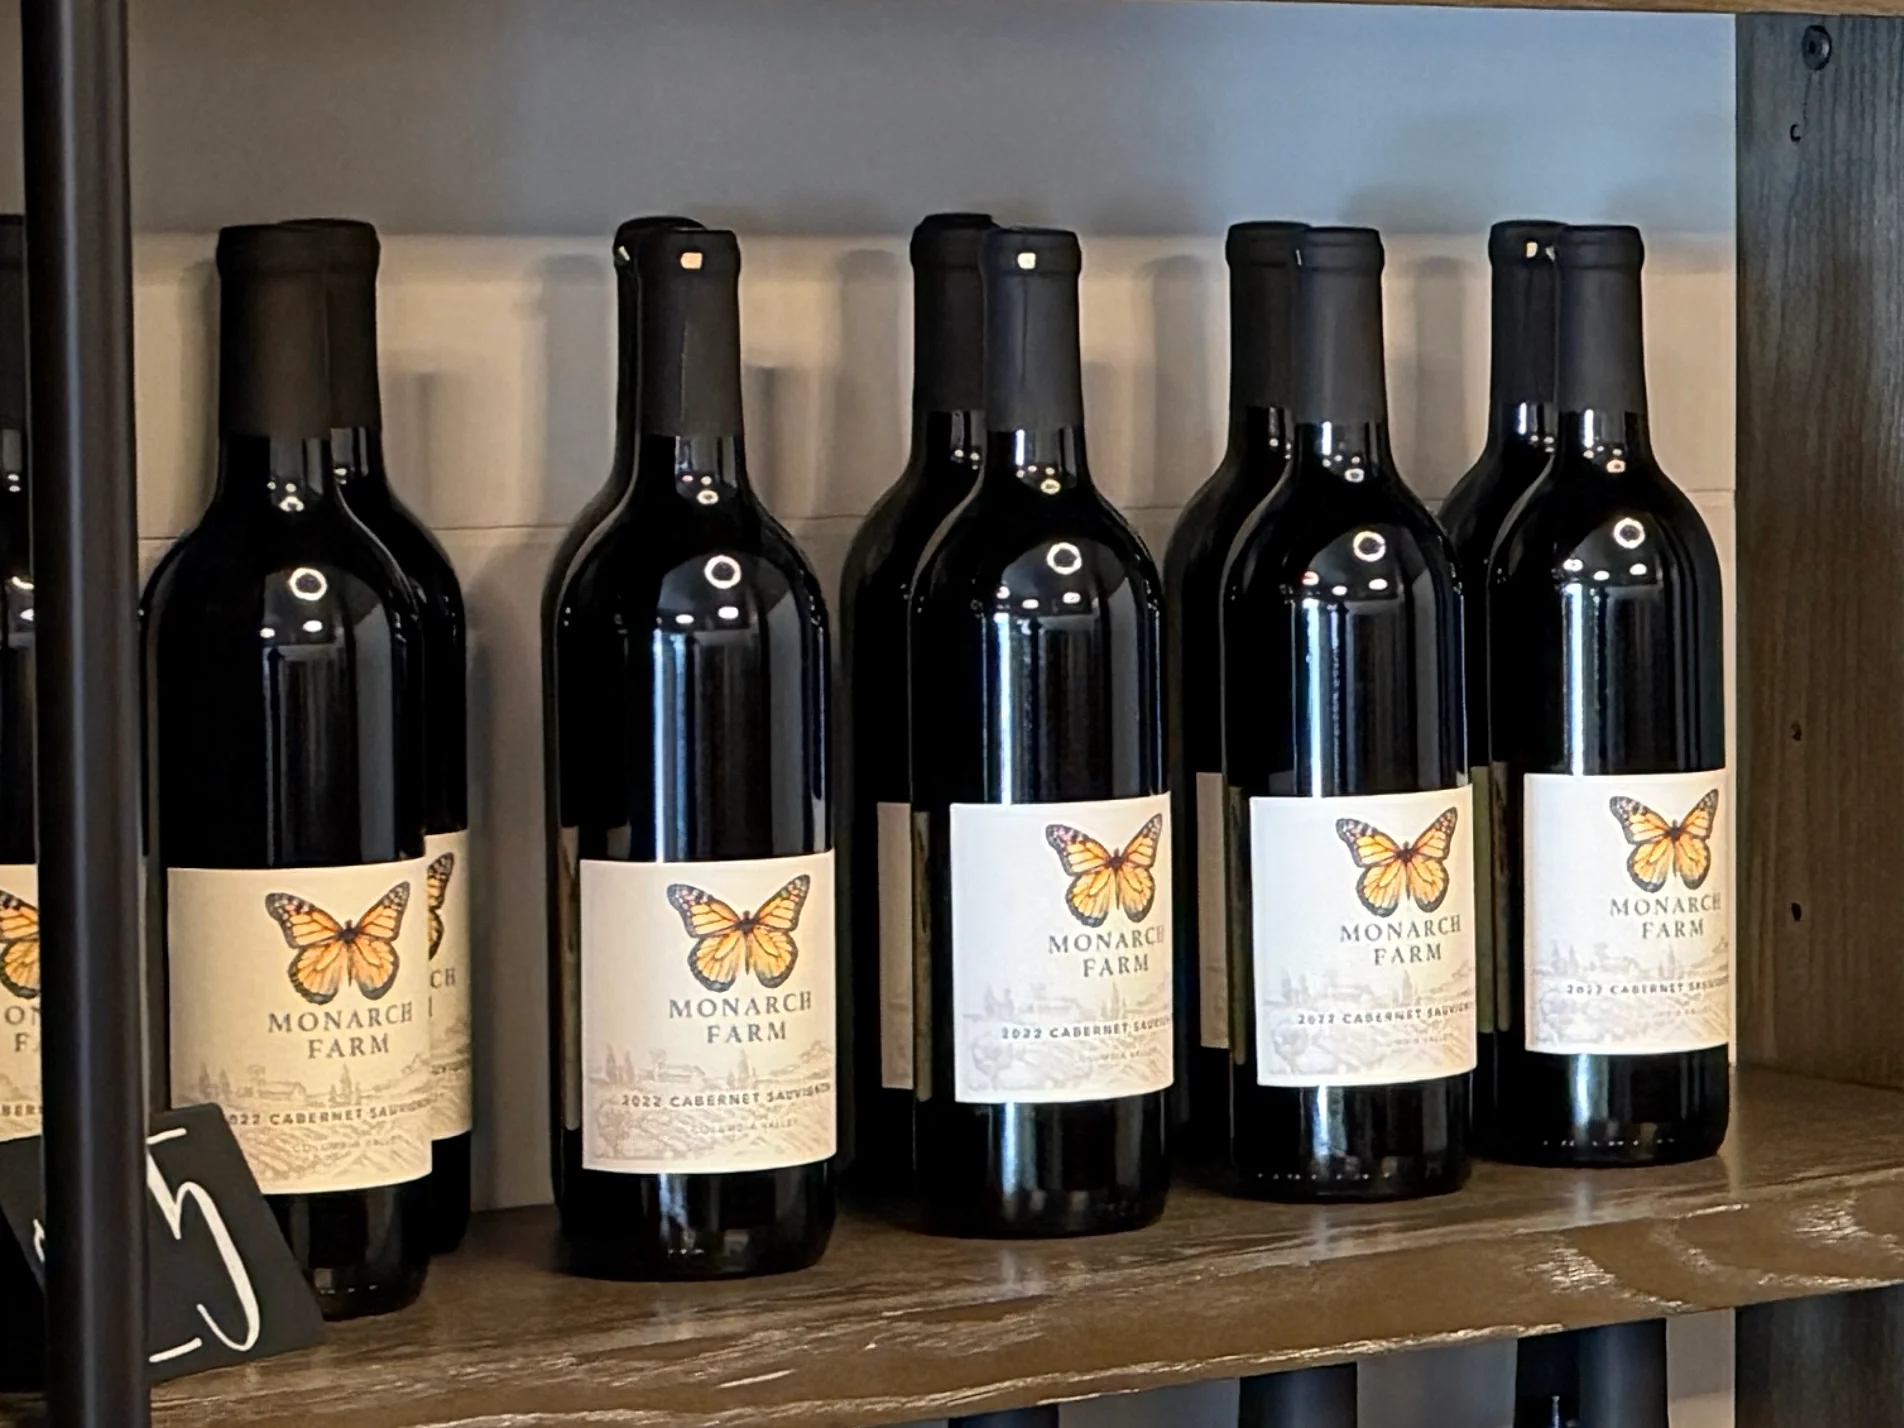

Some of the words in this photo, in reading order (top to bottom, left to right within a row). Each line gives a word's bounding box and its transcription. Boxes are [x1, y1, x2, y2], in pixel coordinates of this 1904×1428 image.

[1609, 892, 1721, 918] MONARCH
[1047, 924, 1166, 955] MONARCH
[1339, 914, 1462, 943] MONARCH
[1641, 918, 1705, 940] FARM
[1082, 953, 1149, 978] FARM
[1373, 942, 1442, 966] FARM
[1609, 983, 1684, 996] CABERNET
[668, 991, 813, 1019] MONARCH
[1341, 1008, 1422, 1025] CABERNET
[267, 1001, 414, 1034] MONARCH
[706, 1020, 787, 1044] FARM
[1048, 1022, 1129, 1039] CABERNET
[307, 1033, 390, 1060] FARM
[621, 1094, 662, 1108] 2022
[669, 1092, 760, 1108] CABERNET
[228, 1111, 261, 1127] 022
[269, 1107, 364, 1126] CABERNET
